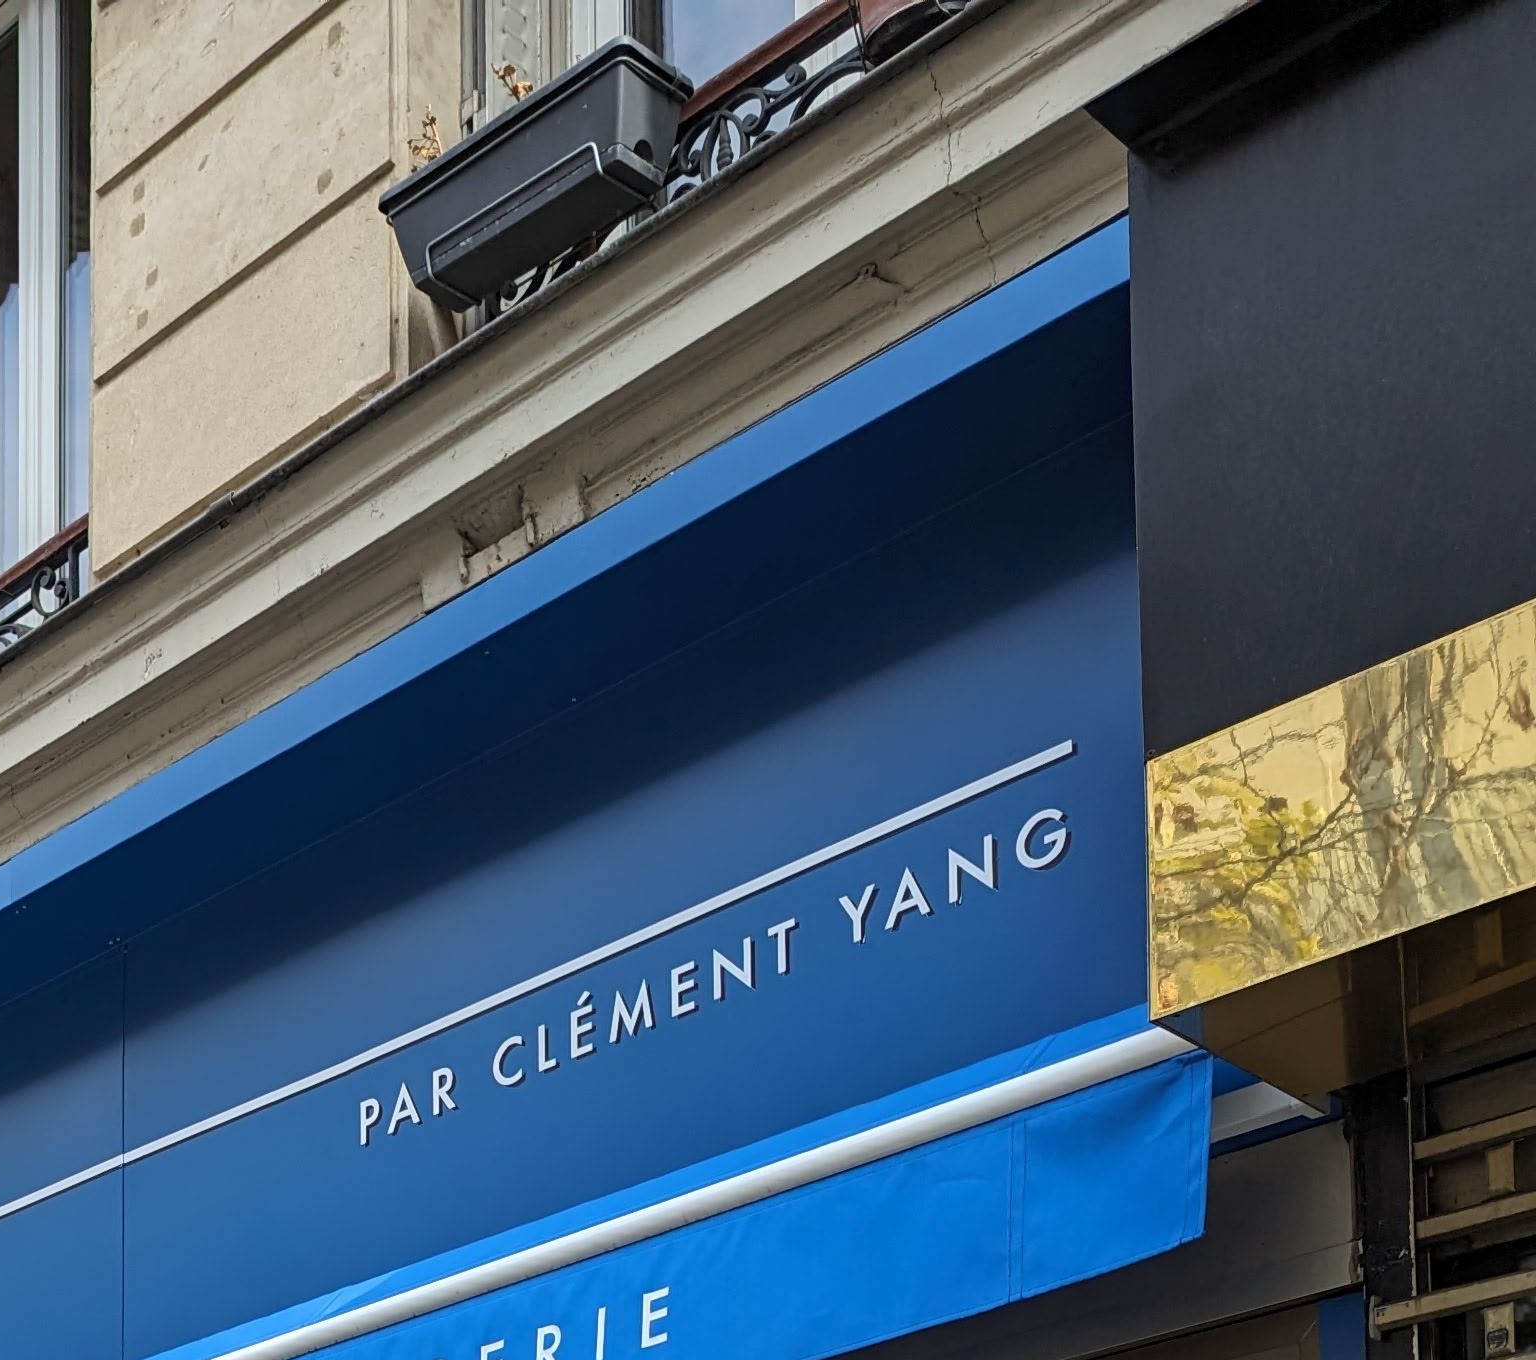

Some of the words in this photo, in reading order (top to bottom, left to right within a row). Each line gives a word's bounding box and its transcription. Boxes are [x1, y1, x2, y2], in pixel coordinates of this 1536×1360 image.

[358, 1065, 460, 1146] PAR
[492, 916, 800, 1090] CLÉMENT
[838, 807, 1073, 945] YANG
